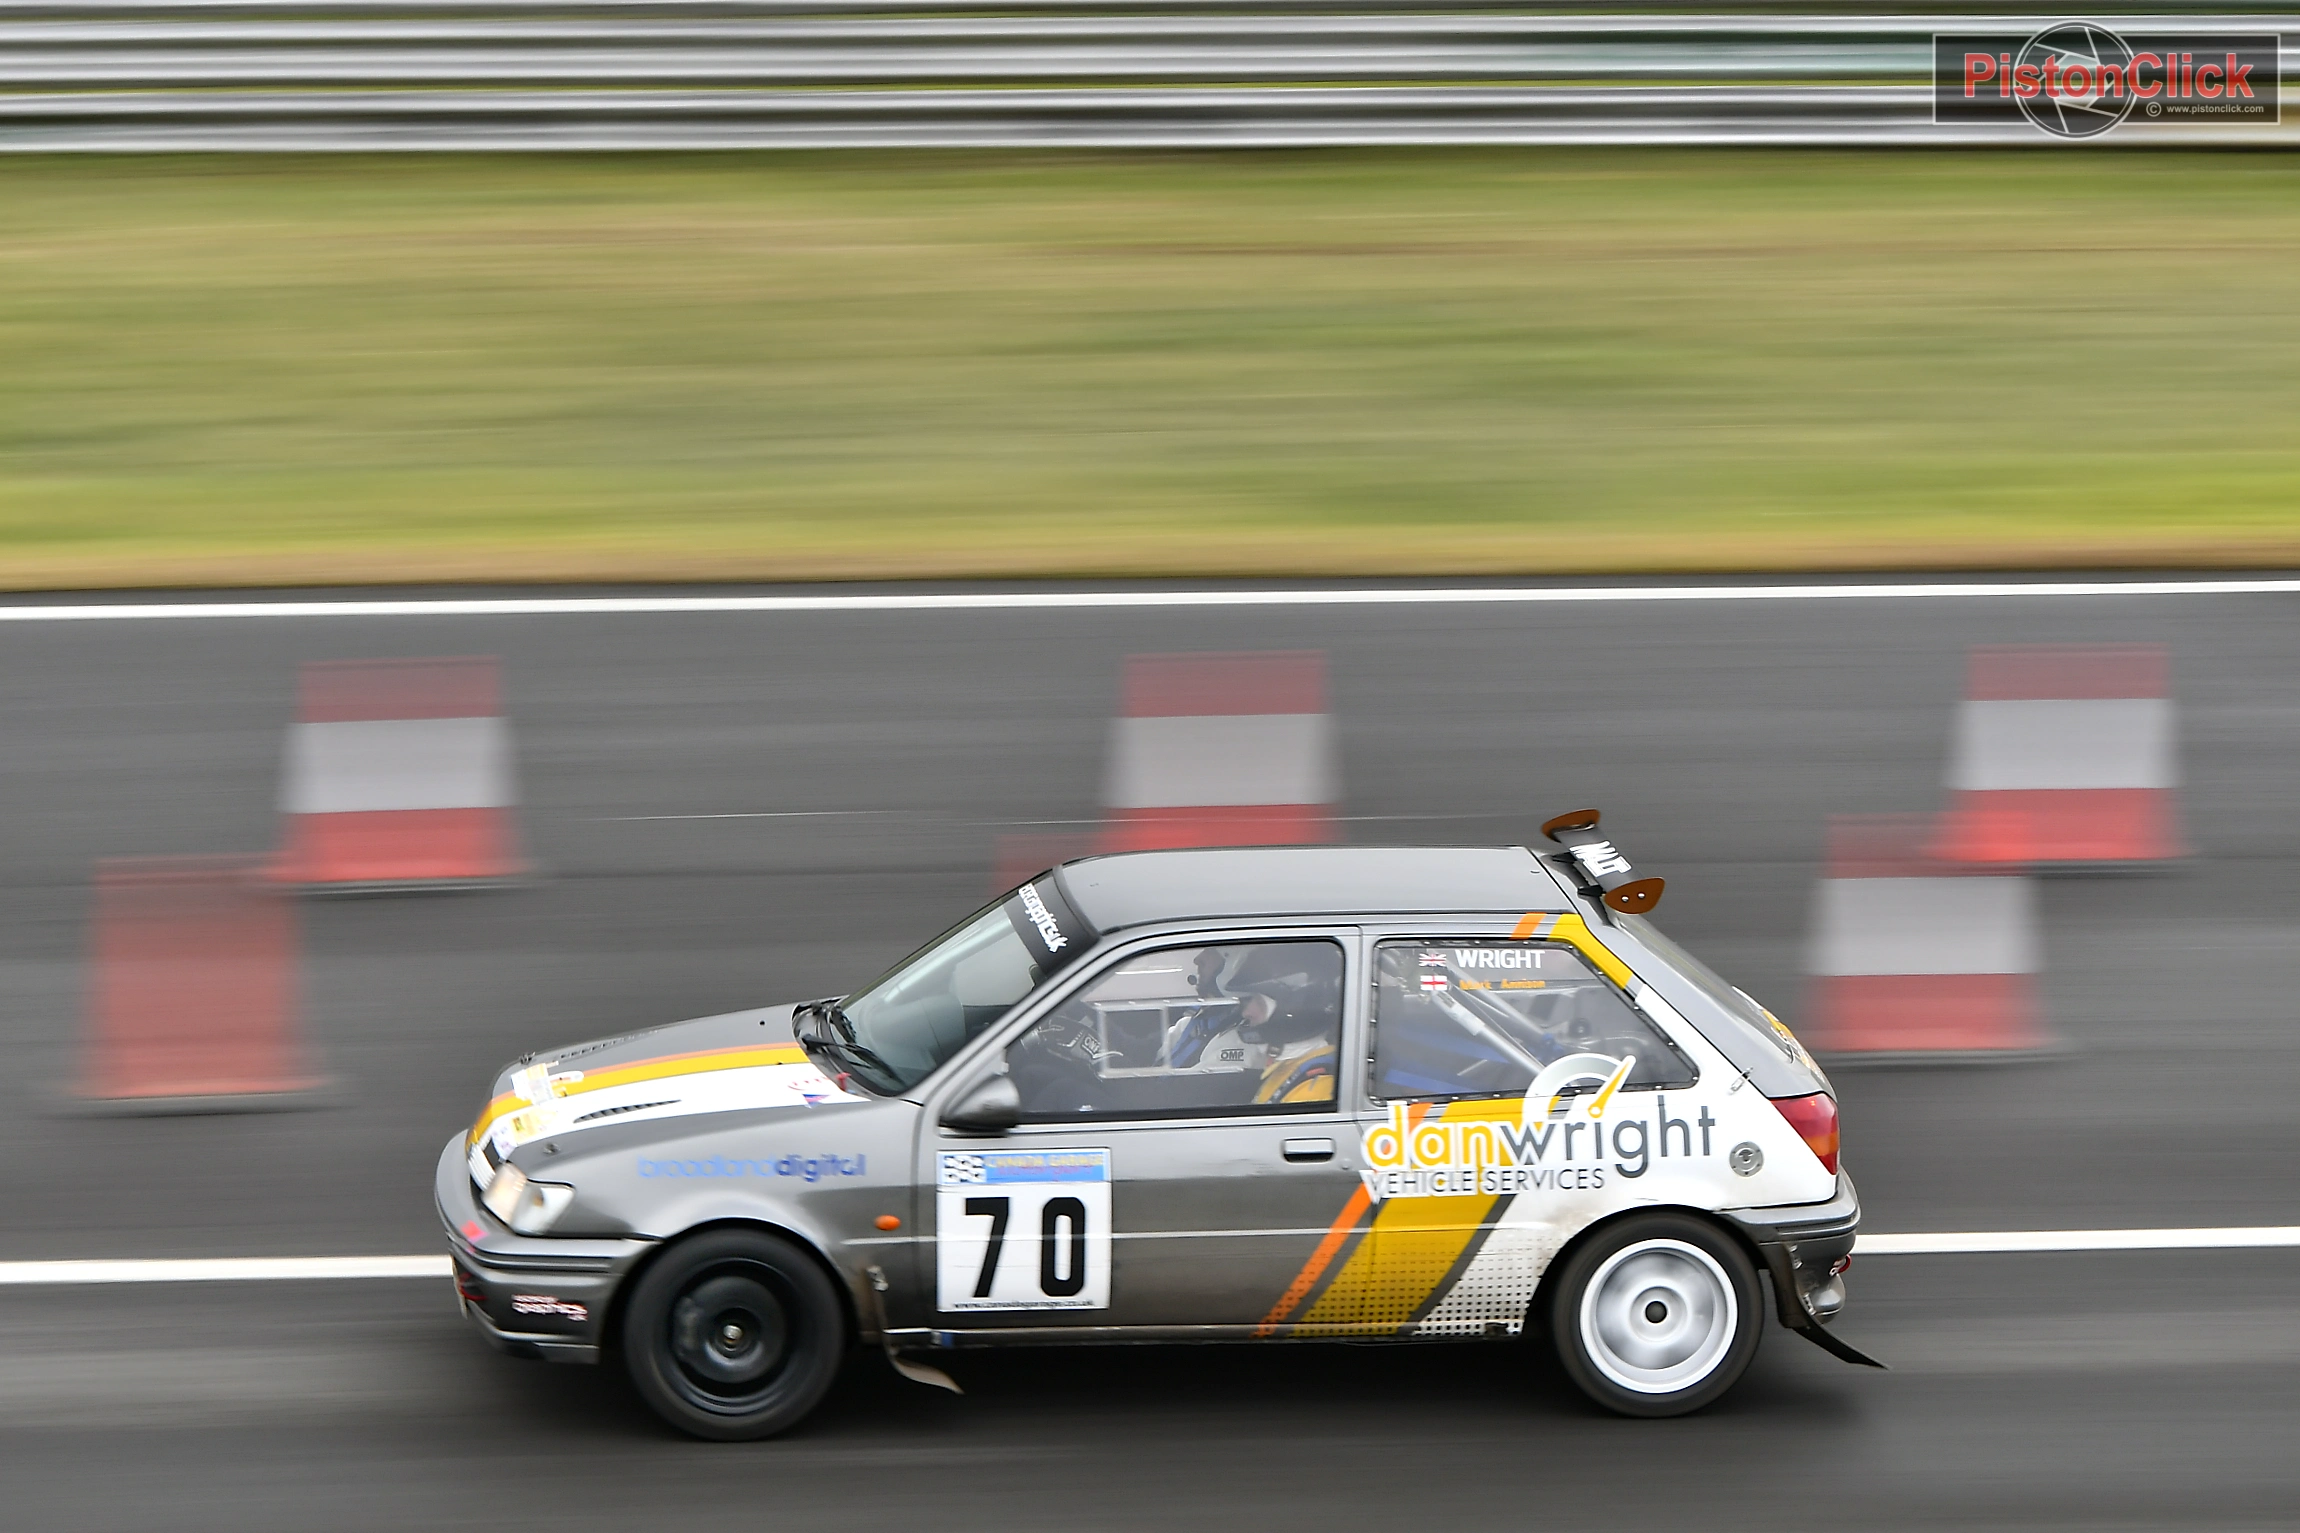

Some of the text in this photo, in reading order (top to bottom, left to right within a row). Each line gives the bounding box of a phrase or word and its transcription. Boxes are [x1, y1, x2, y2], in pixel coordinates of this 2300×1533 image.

[1455, 949, 1546, 969] WRIGHT
[1219, 1048, 1245, 1061] OMP
[1364, 1094, 1716, 1178] danwright
[1363, 1168, 1606, 1197] VEHICLE SERVICES
[965, 1196, 1085, 1298] 70
